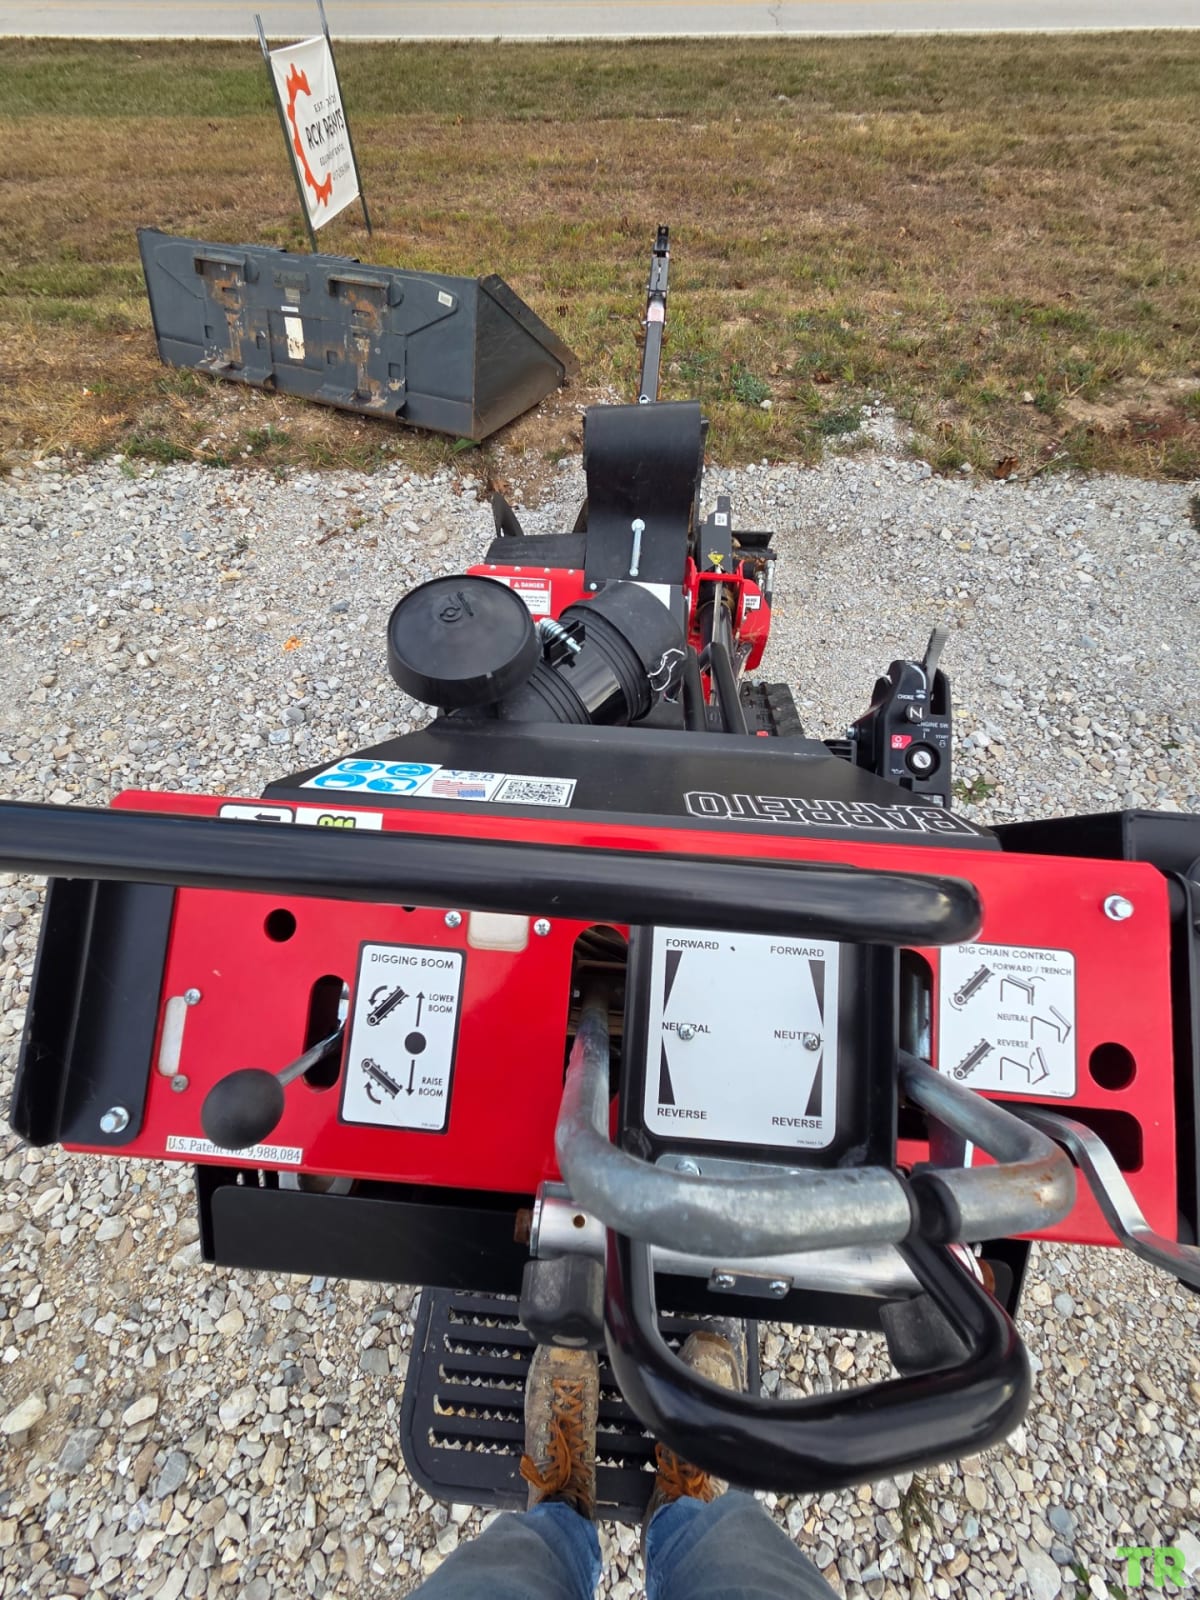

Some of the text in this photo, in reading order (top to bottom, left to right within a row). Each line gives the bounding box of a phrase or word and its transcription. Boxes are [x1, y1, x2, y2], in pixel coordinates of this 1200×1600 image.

[683, 791, 979, 836] BARRETO
[666, 938, 719, 950] FORWARD
[770, 946, 824, 957] FORWARD
[958, 946, 1058, 962] DIG CHAIN CONTROL
[371, 953, 454, 969] DIGGING BOOM
[992, 963, 1033, 973] FORWARD
[1041, 966, 1072, 976] TRENCH
[429, 993, 454, 1003] LOWER
[428, 1004, 453, 1013] BOOM
[997, 1013, 1029, 1023] NEUTRAL
[997, 1039, 1029, 1048] REVERSE
[422, 1077, 443, 1086] RAISE
[419, 1088, 443, 1097] BOOM
[657, 1107, 708, 1120] REVERSE
[771, 1116, 823, 1129] REVERSE
[168, 1137, 187, 1150] U.S.
[248, 1146, 300, 1162] 9,988,084
